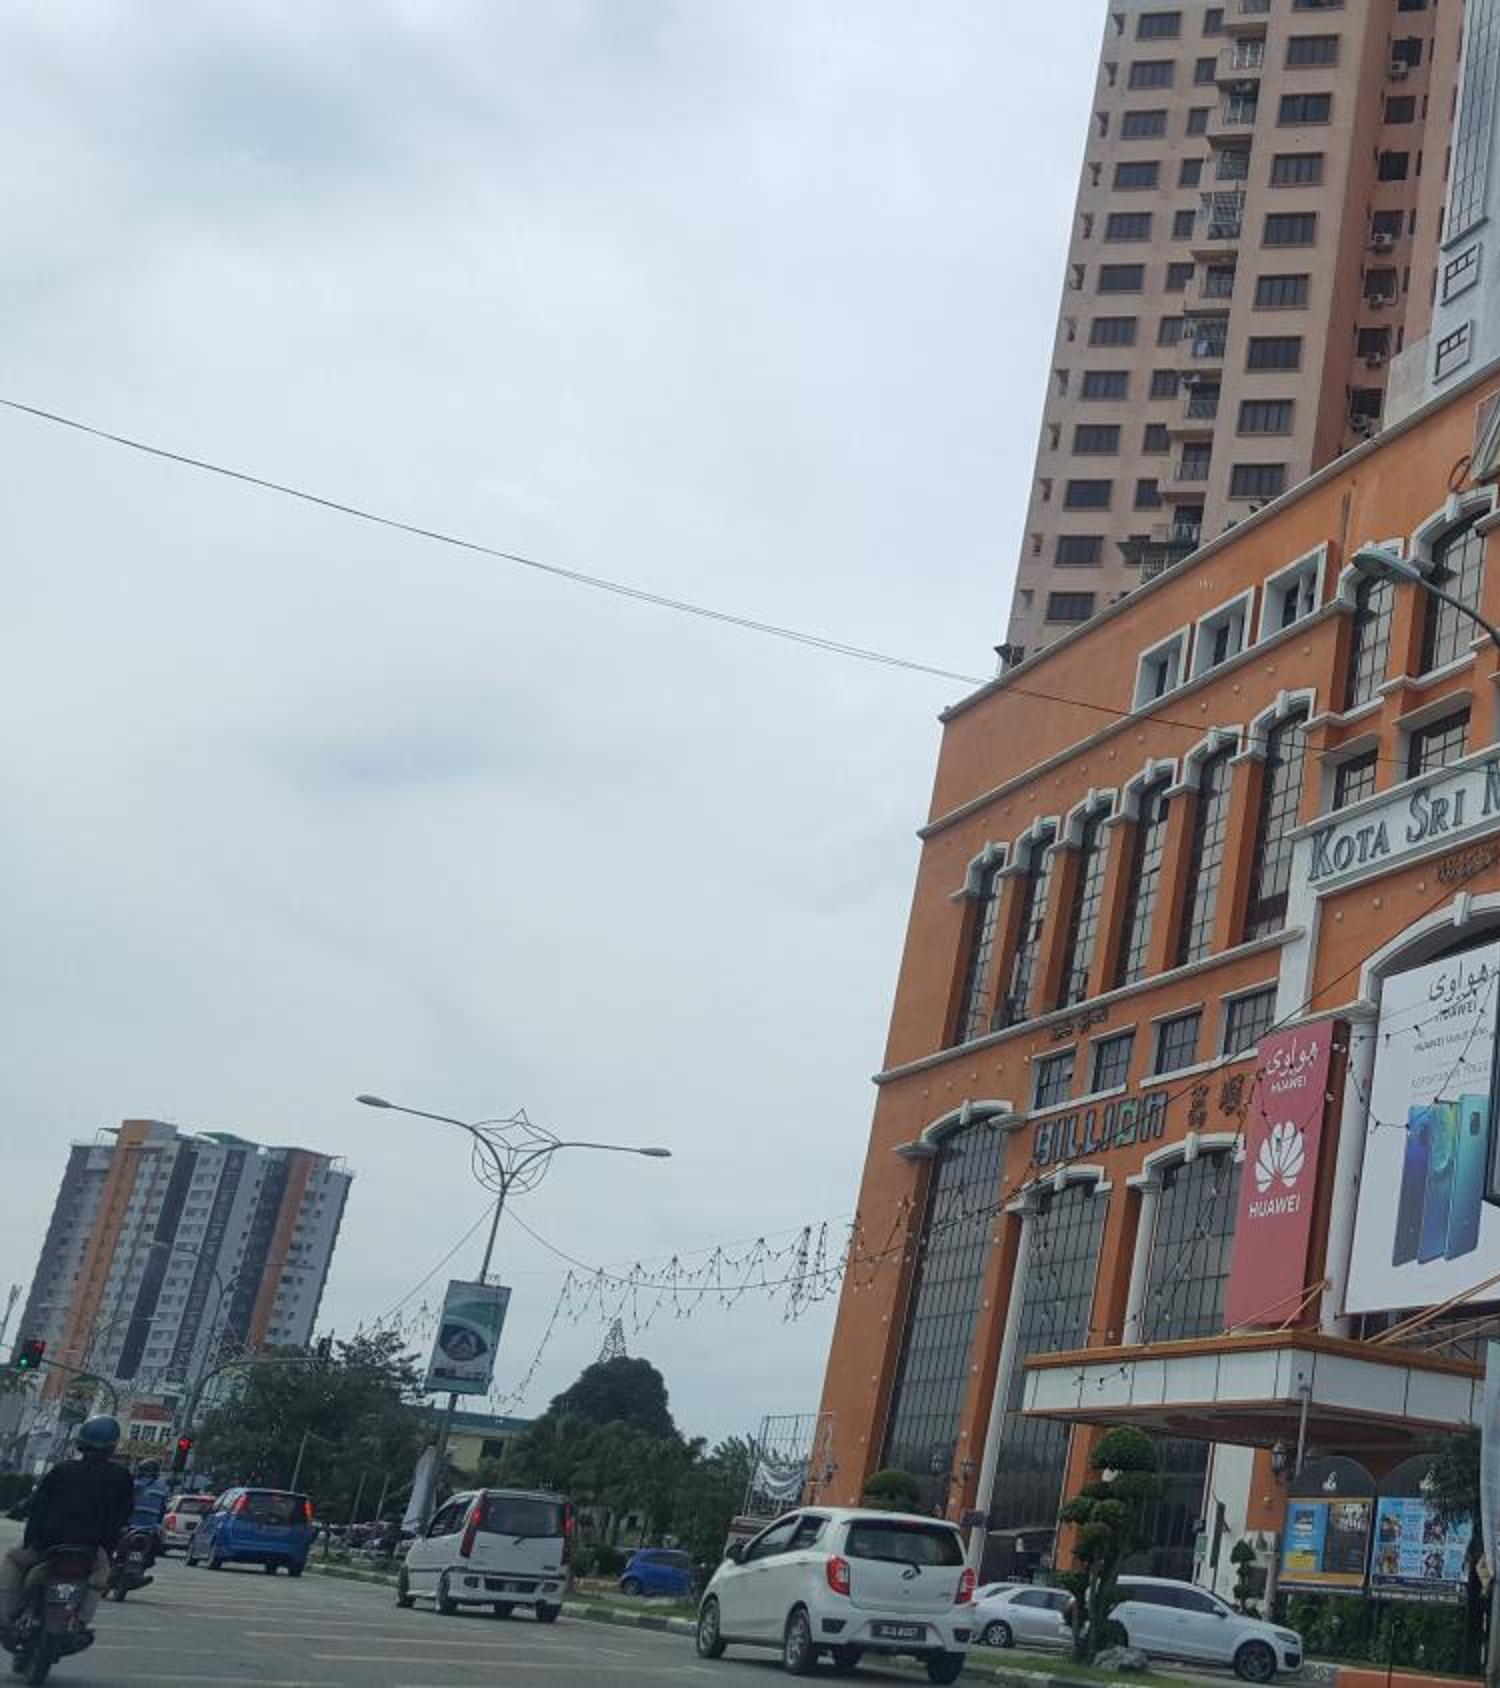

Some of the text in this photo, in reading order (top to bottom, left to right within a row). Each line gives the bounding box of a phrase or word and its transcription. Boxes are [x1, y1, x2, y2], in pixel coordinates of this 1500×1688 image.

[1307, 821, 1391, 882] KOTA
[1406, 786, 1466, 843] SRI
[1249, 1196, 1301, 1218] HUAWEI
